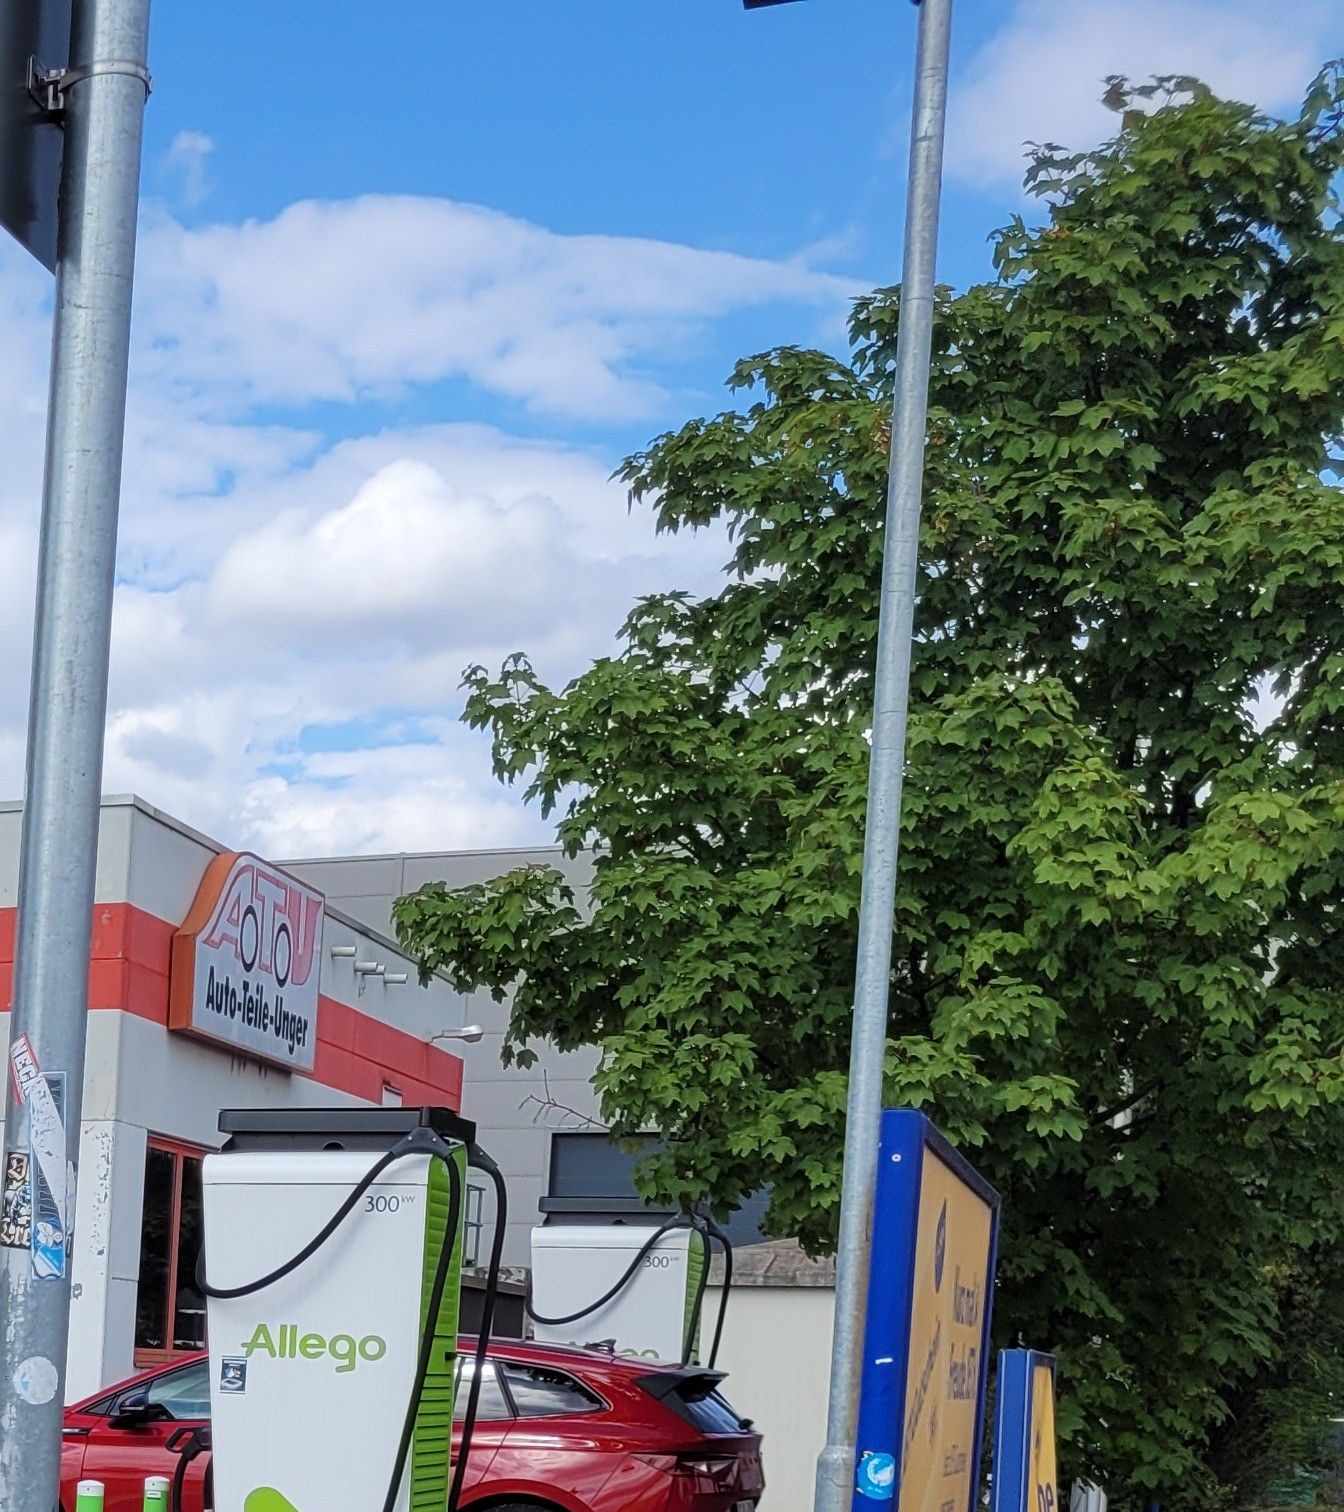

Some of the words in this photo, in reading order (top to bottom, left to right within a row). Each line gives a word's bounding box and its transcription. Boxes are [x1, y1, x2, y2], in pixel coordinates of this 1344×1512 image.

[206, 966, 309, 1056] Auto-Teile-Unger
[364, 1195, 400, 1213] 300
[644, 1256, 669, 1268] 300
[241, 1324, 387, 1374] Allego
